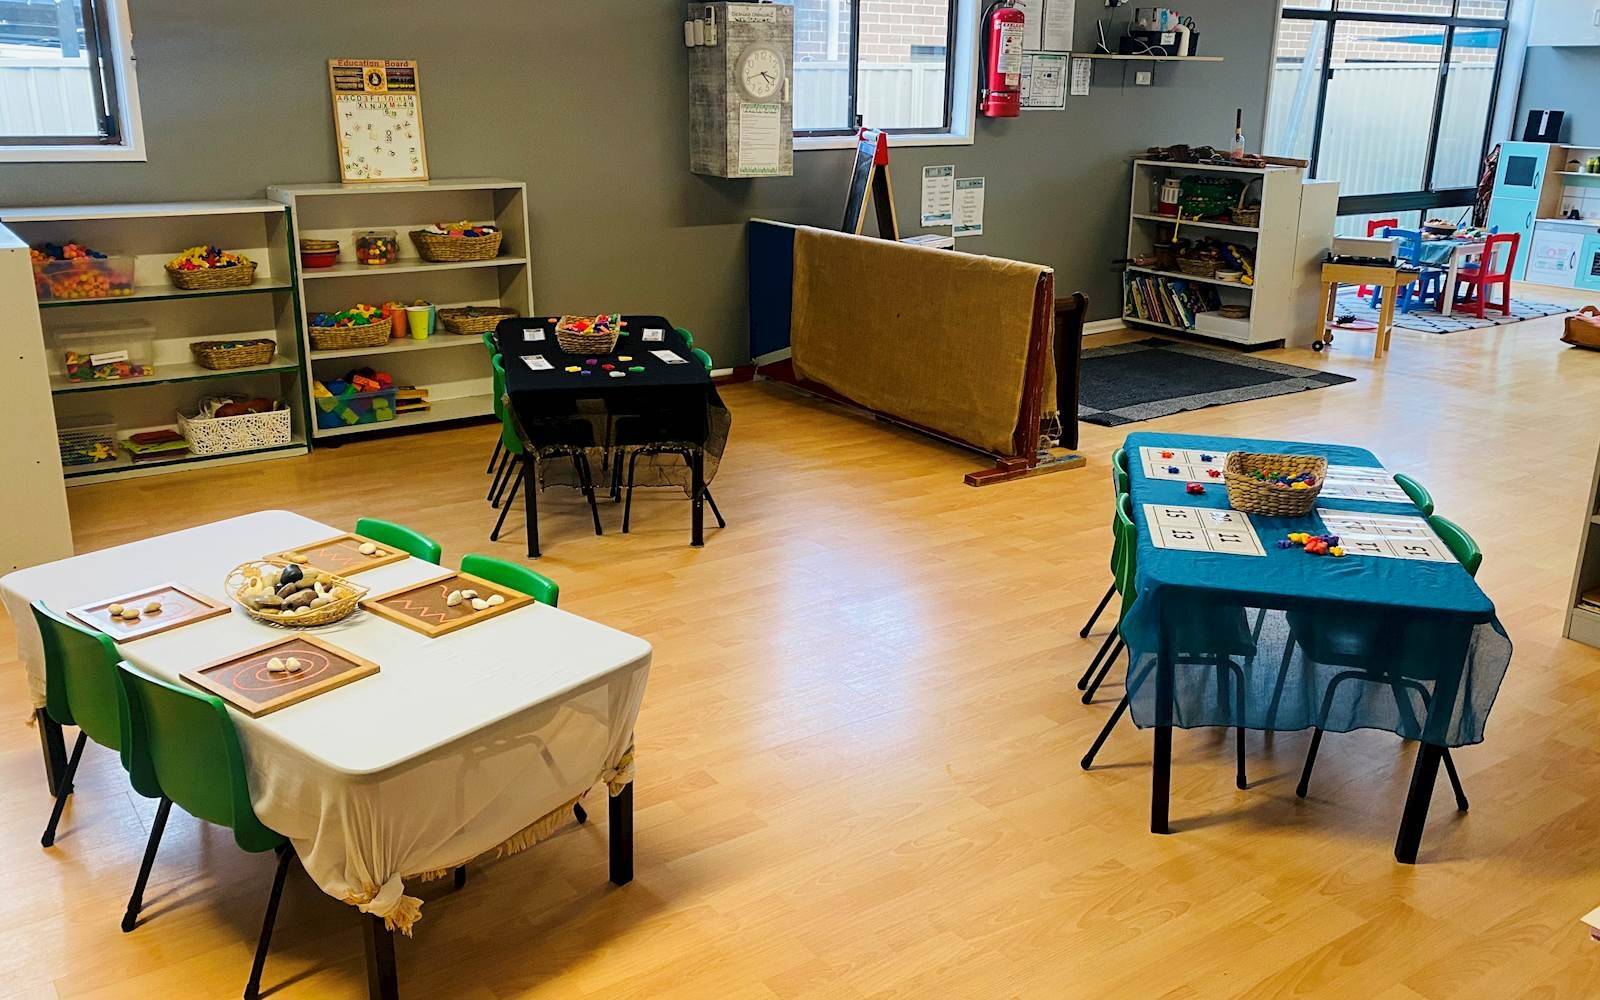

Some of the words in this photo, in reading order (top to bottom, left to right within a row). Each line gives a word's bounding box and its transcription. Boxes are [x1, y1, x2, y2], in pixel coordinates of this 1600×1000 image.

[337, 59, 380, 67] Education
[1165, 509, 1187, 518] 15
[1172, 529, 1195, 540] 13
[1218, 533, 1242, 543] 11
[1355, 542, 1381, 553] 11
[1403, 545, 1430, 557] 15
